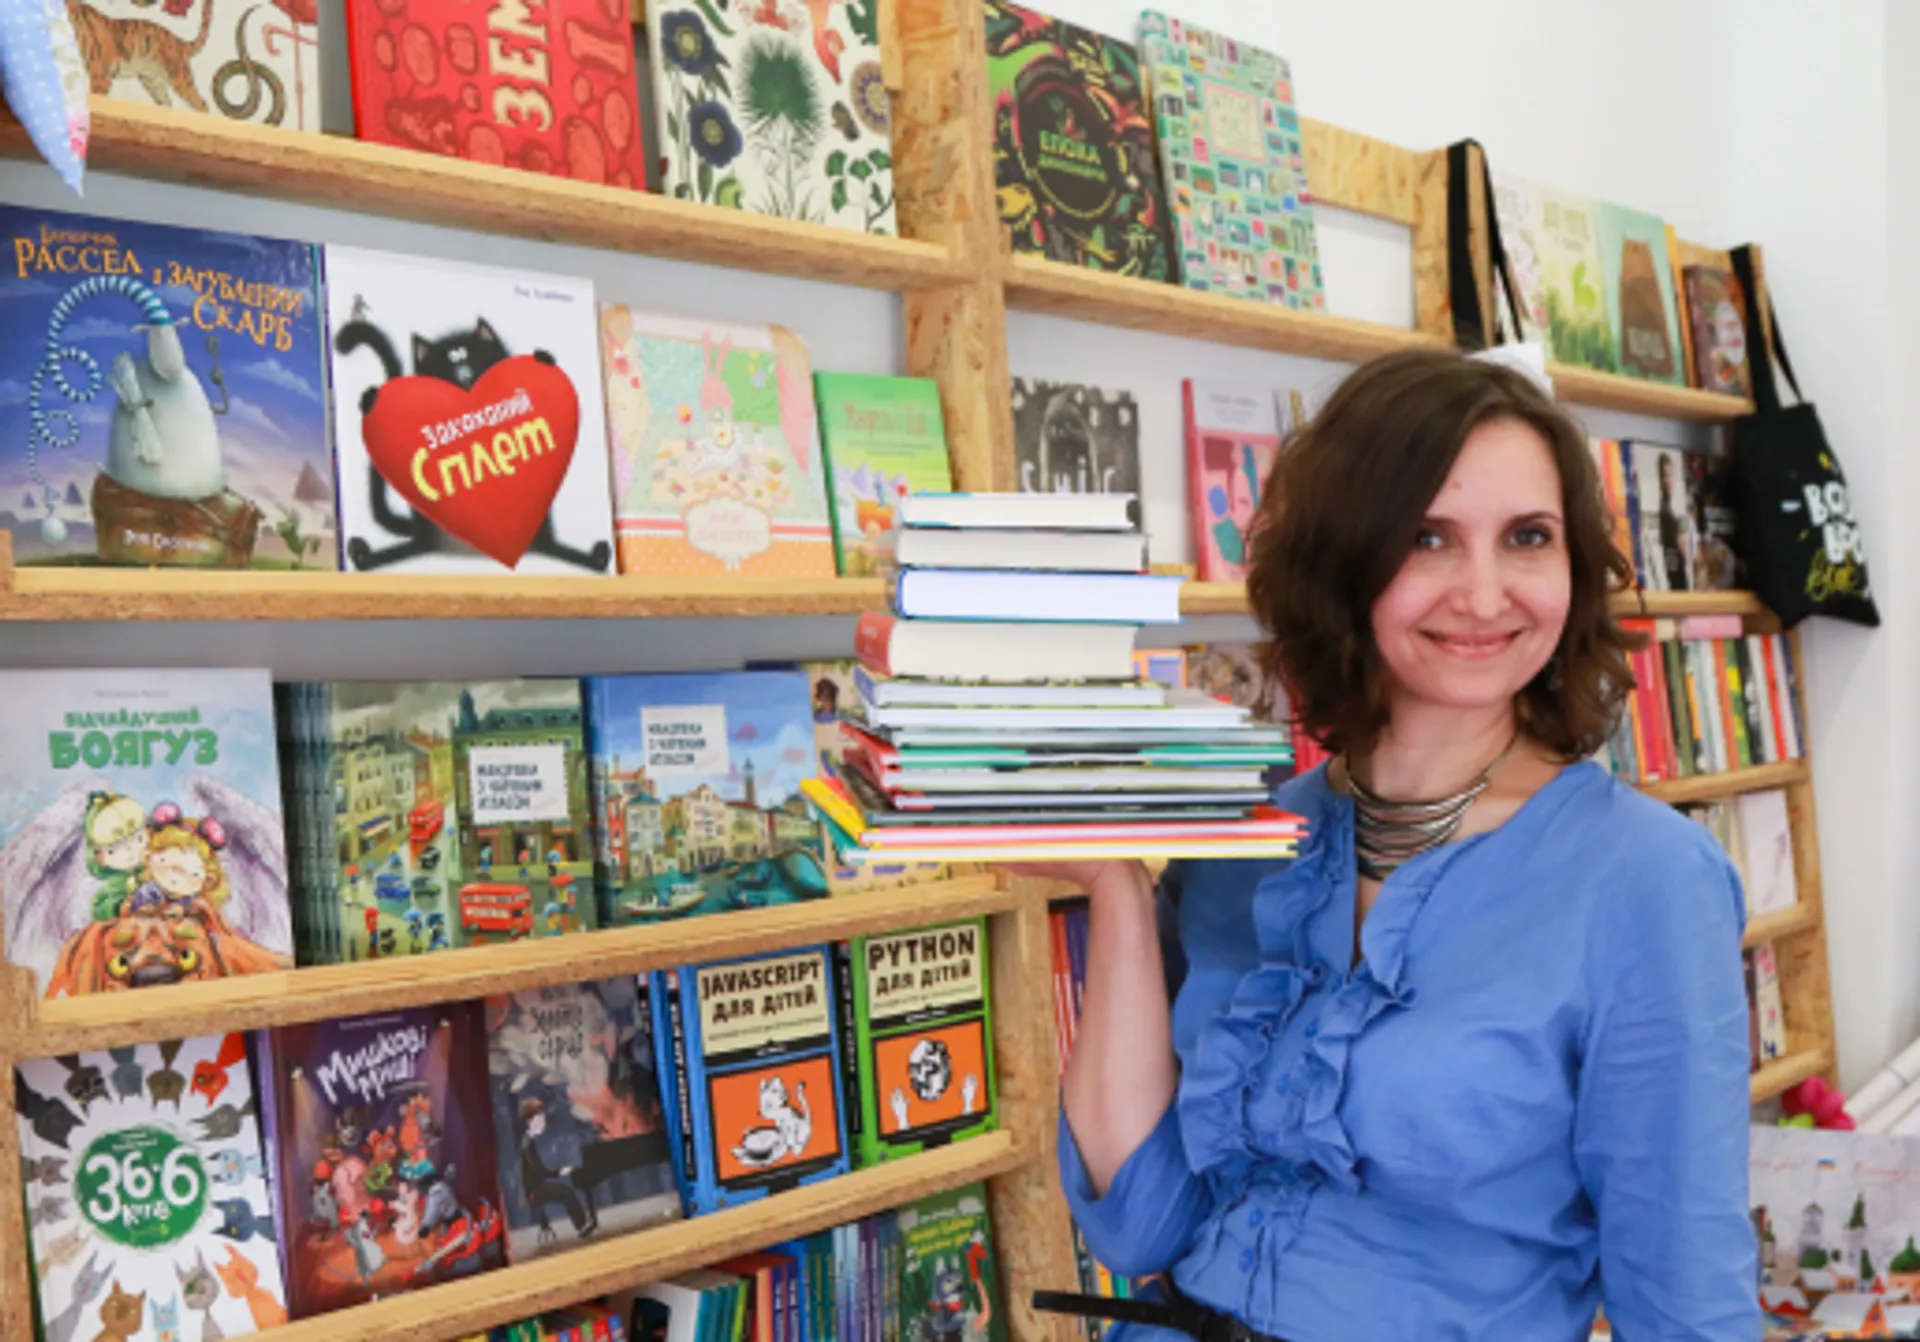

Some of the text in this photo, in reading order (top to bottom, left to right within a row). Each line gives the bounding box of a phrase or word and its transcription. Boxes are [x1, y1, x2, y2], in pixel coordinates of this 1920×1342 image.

[411, 417, 556, 501] Сплет
[48, 727, 219, 770] БОЯГУЗ
[869, 928, 974, 971] PYTHON
[702, 959, 820, 1000] JAVASCRIPT
[876, 957, 971, 997] ДЛЯ ДІТЕЙ
[713, 983, 816, 1024] ДЛЯ ДІТЕЙ
